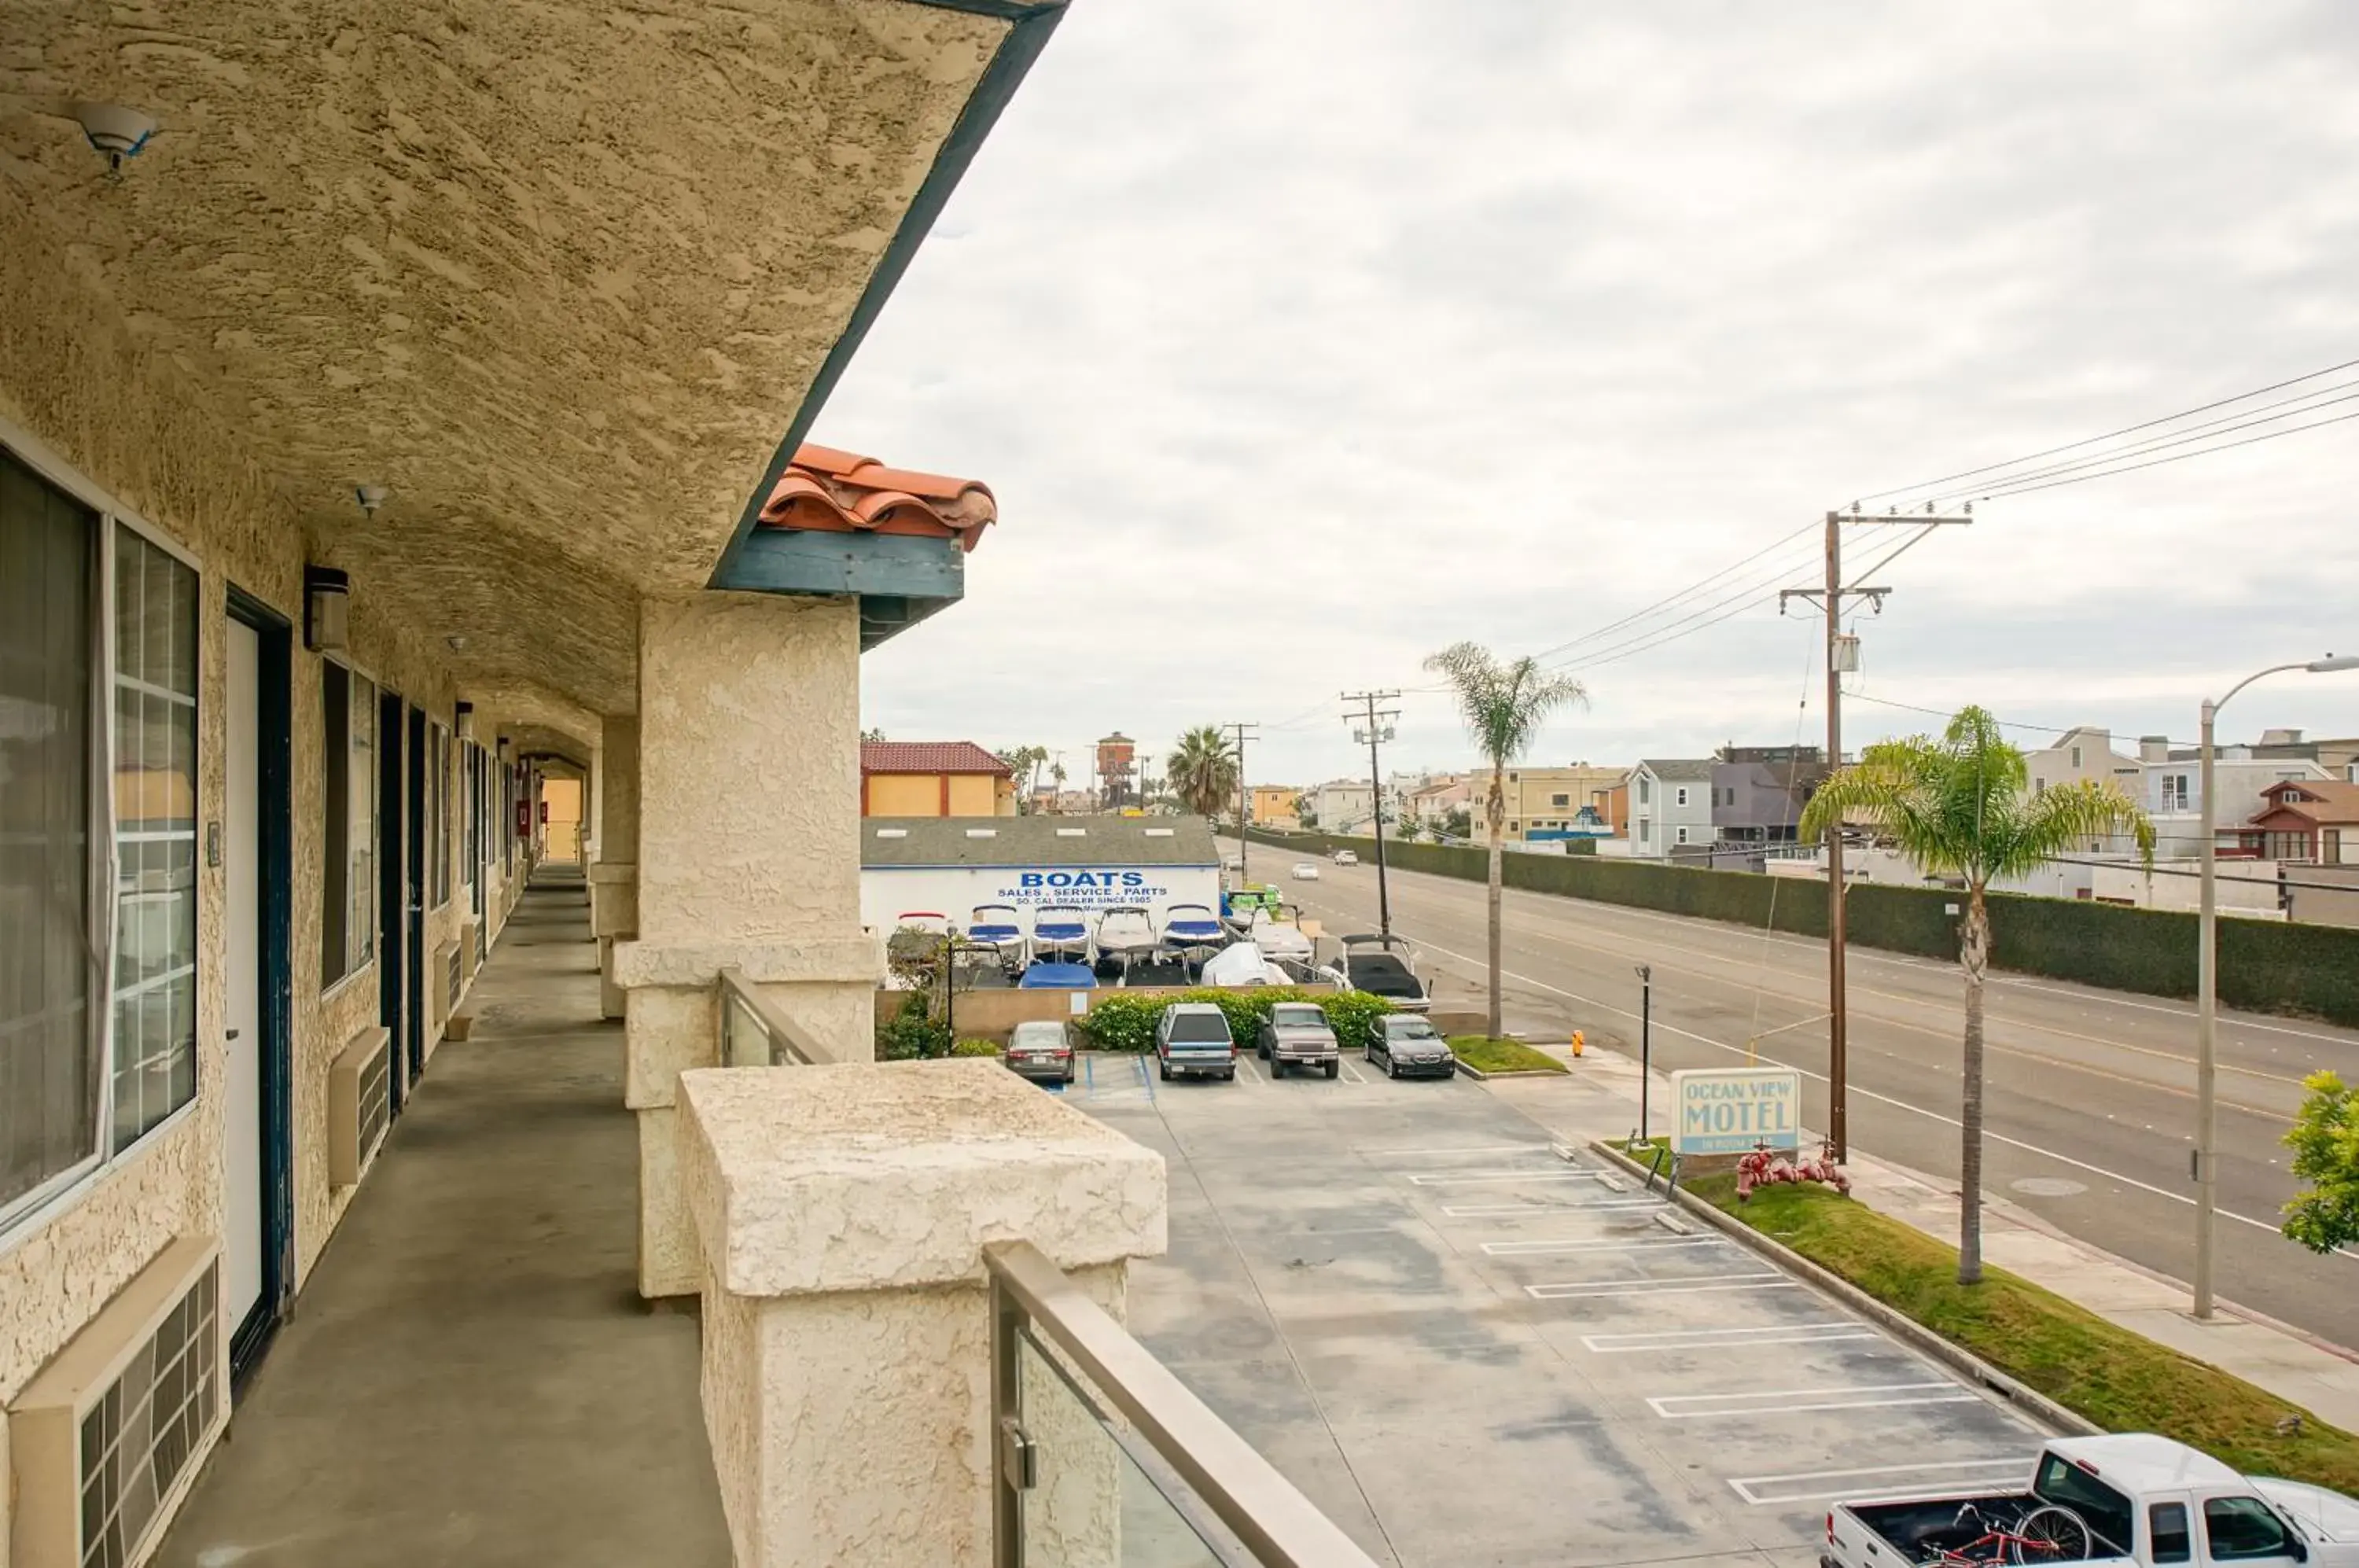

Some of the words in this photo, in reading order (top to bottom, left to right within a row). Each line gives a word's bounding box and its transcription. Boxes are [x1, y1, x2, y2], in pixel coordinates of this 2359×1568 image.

[1021, 872, 1143, 887] BOATS
[1687, 1083, 1745, 1100] OCEAN
[1750, 1080, 1792, 1099] VIEW
[1687, 1102, 1790, 1133] MOTEL
